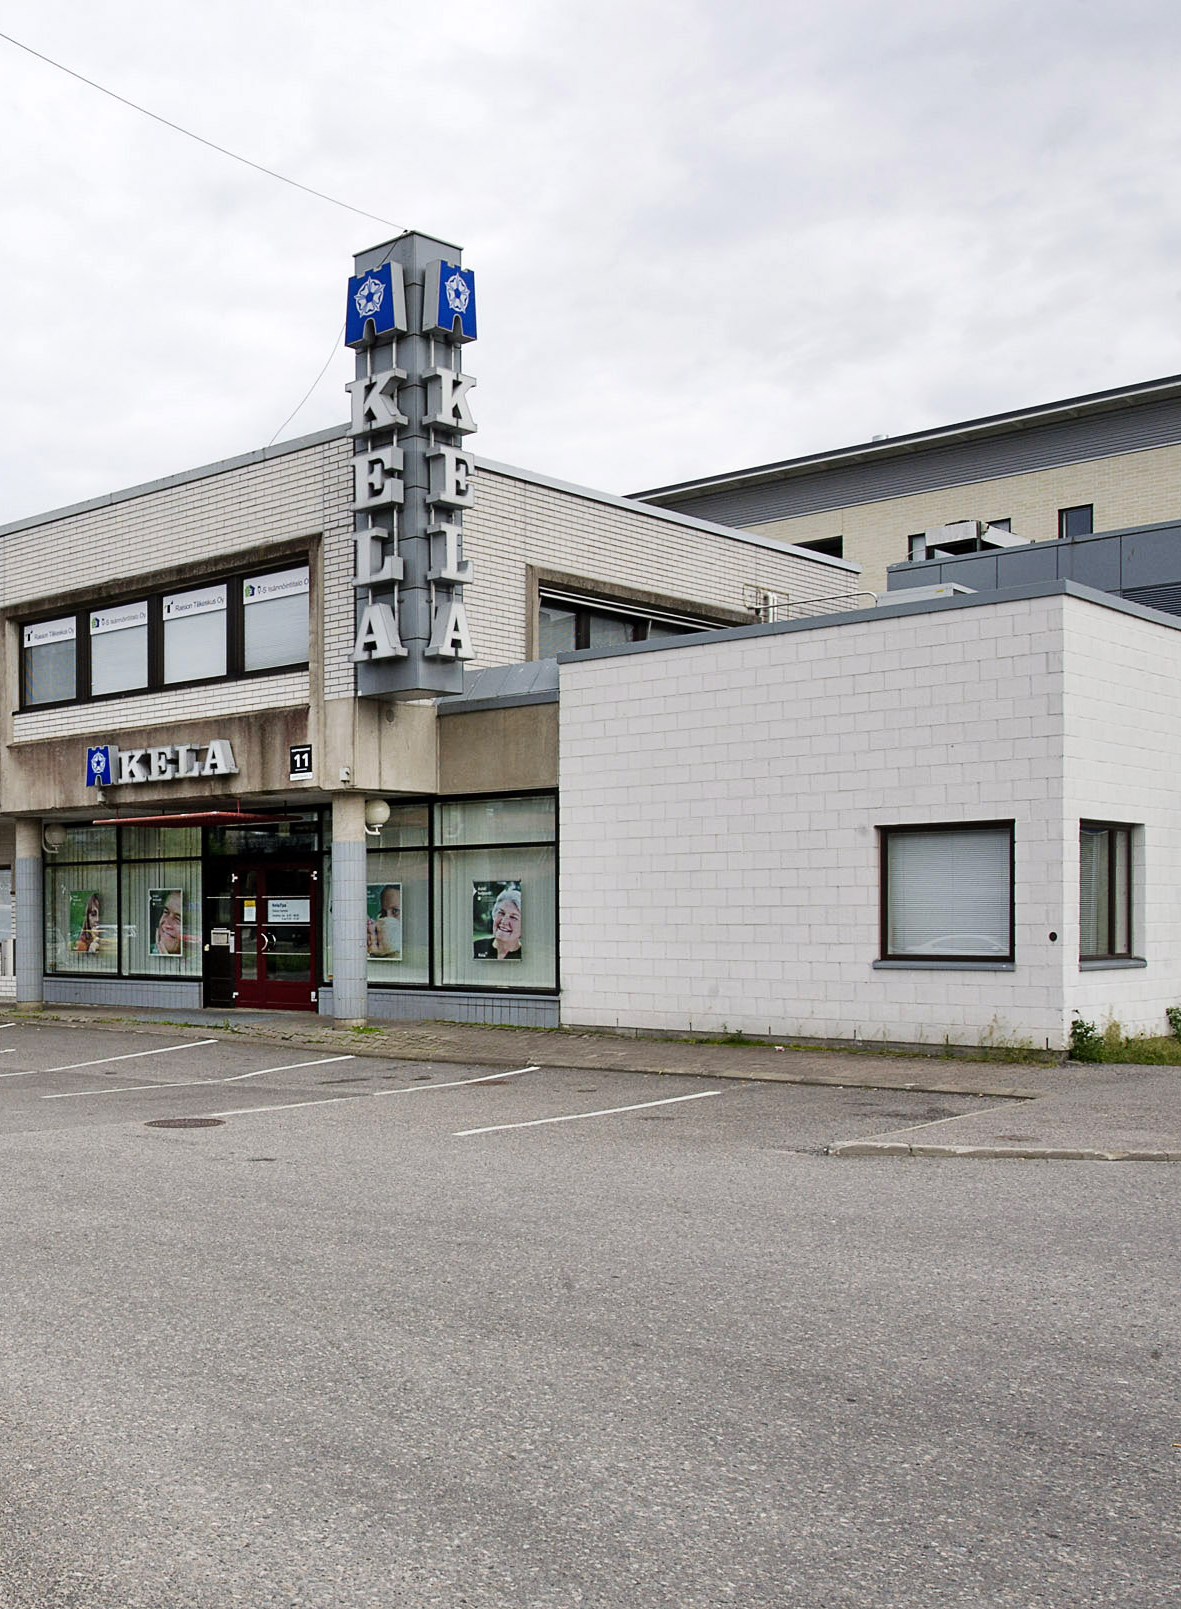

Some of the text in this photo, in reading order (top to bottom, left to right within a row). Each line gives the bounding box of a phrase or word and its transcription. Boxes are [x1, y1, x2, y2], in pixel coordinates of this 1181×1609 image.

[345, 367, 409, 663] KELA
[422, 366, 478, 661] KELA
[117, 739, 240, 785] KELA
[293, 752, 309, 768] 11
